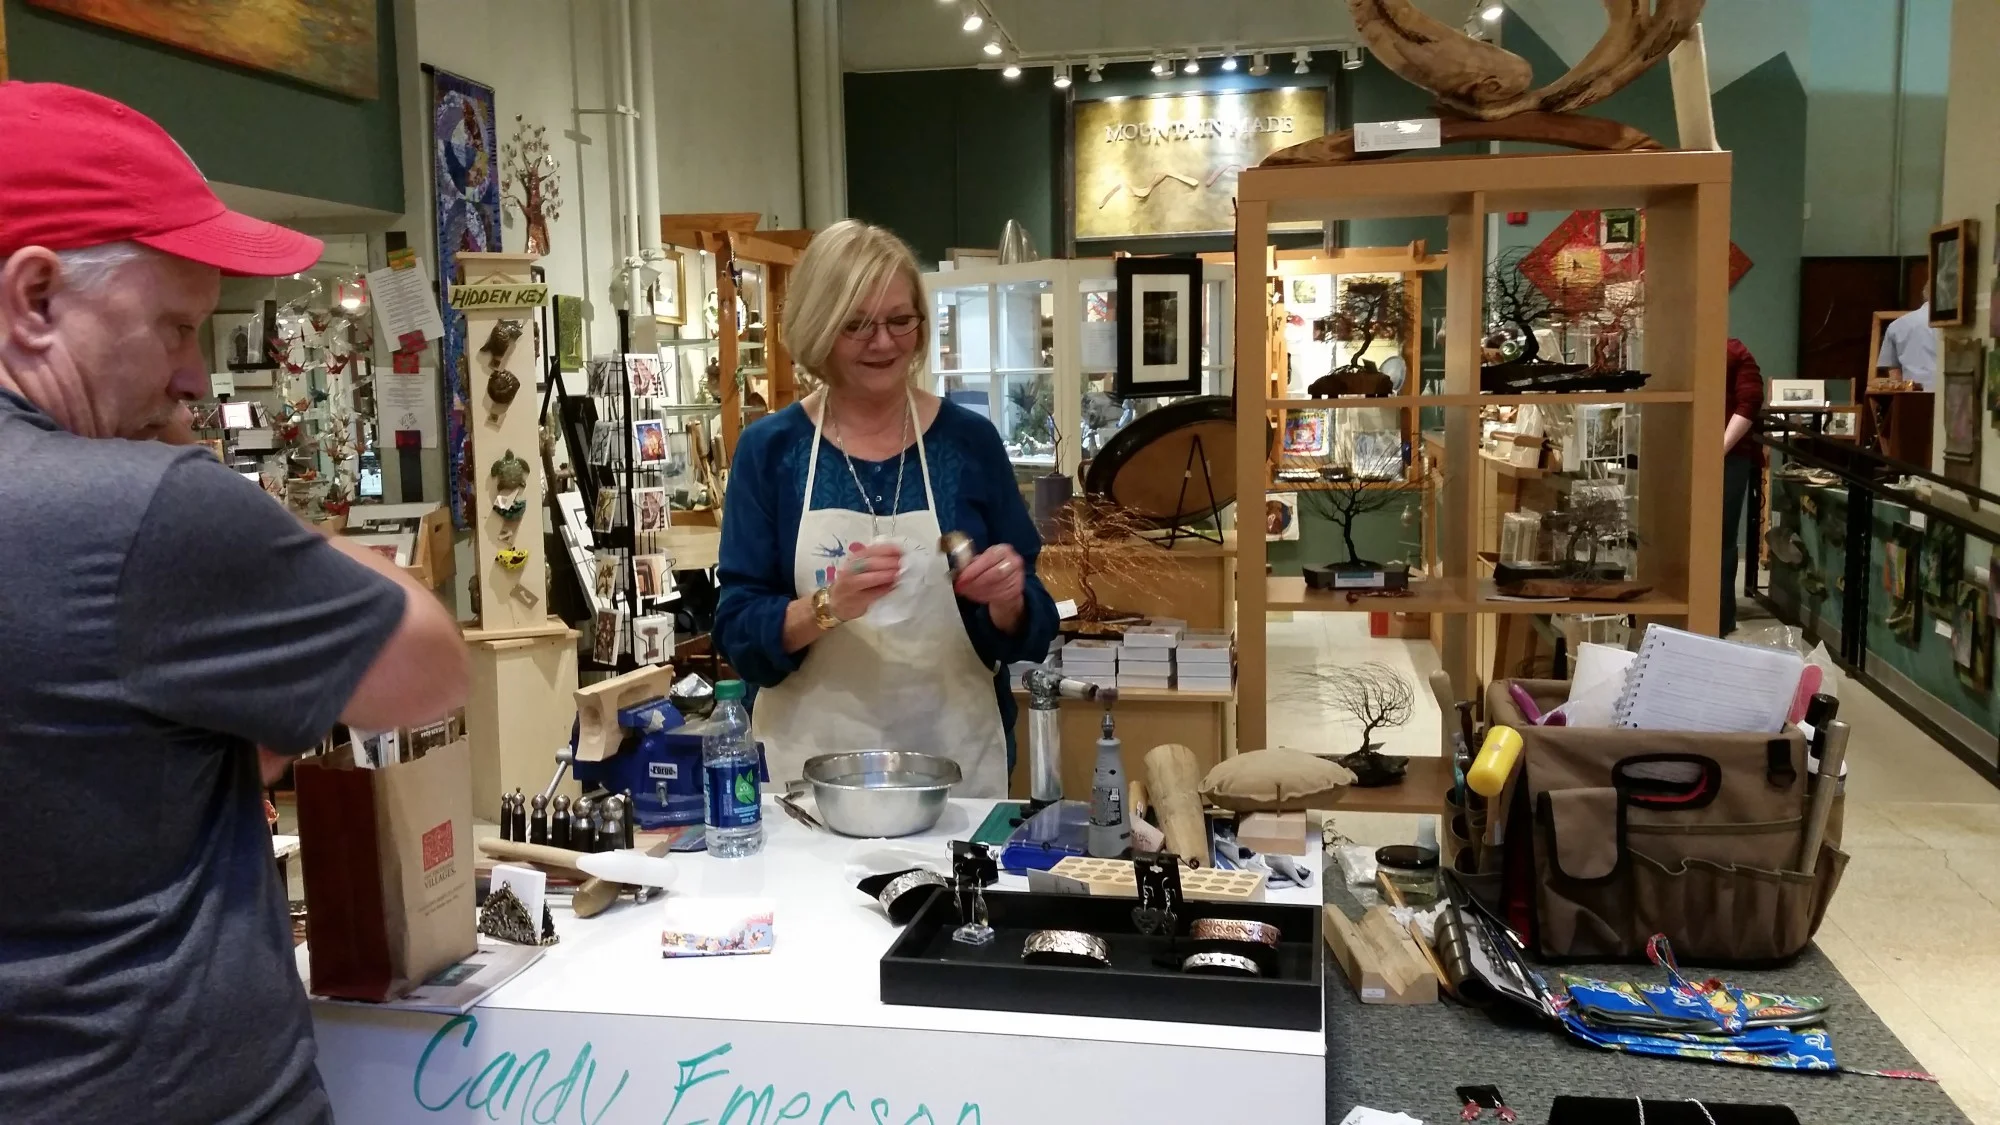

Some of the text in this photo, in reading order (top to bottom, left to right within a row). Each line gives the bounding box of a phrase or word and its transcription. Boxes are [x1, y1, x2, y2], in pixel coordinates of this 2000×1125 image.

[1105, 119, 1223, 147] MOUNTAIN
[451, 287, 548, 308] HIDDEN KEY
[414, 1014, 629, 1125] Candy
